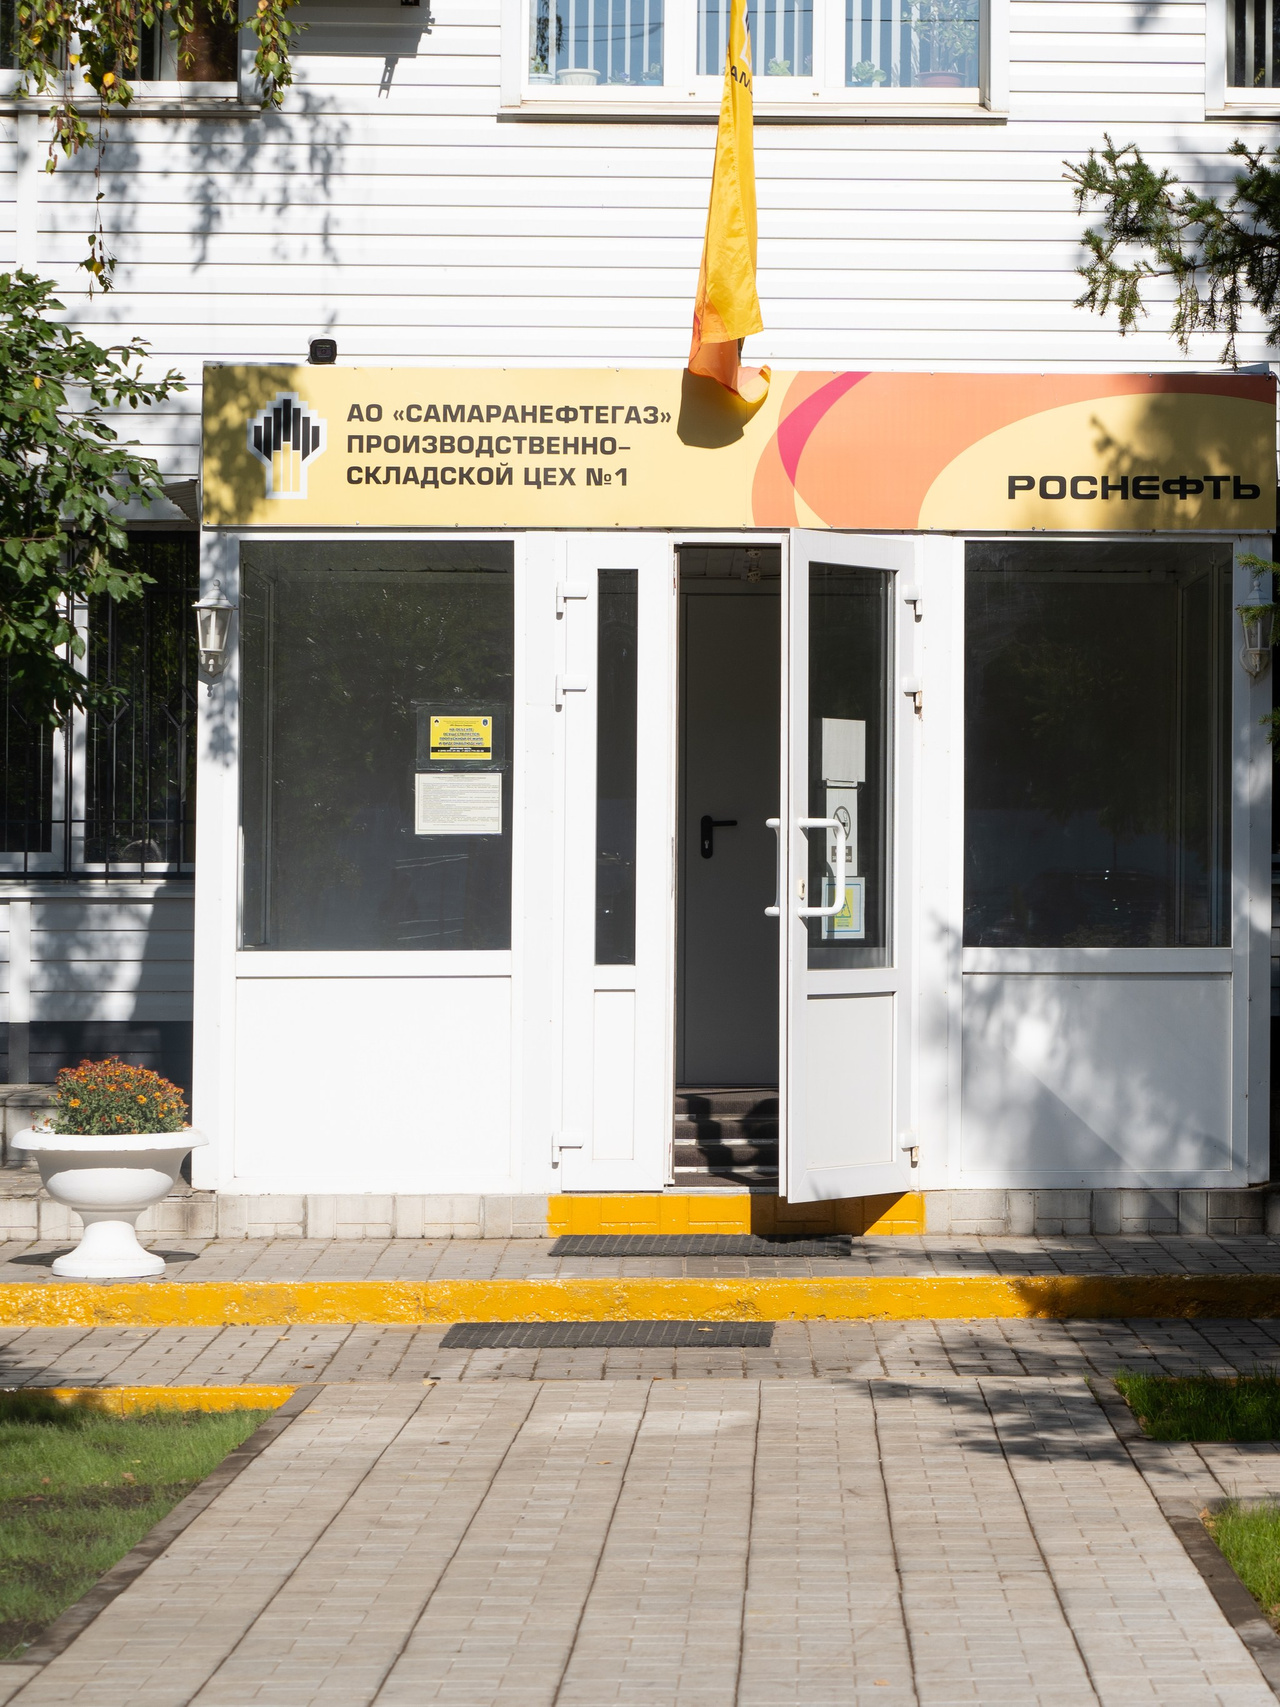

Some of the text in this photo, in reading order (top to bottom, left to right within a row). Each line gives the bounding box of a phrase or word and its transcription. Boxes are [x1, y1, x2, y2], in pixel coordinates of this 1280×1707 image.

[346, 403, 672, 425] АО «САМАРАНЕФТЕГАЗ»
[346, 462, 513, 489] СКЛАДСКОЙ
[523, 467, 576, 490] ЦЕХ
[1007, 475, 1261, 500] РОСНЕФТЬ
